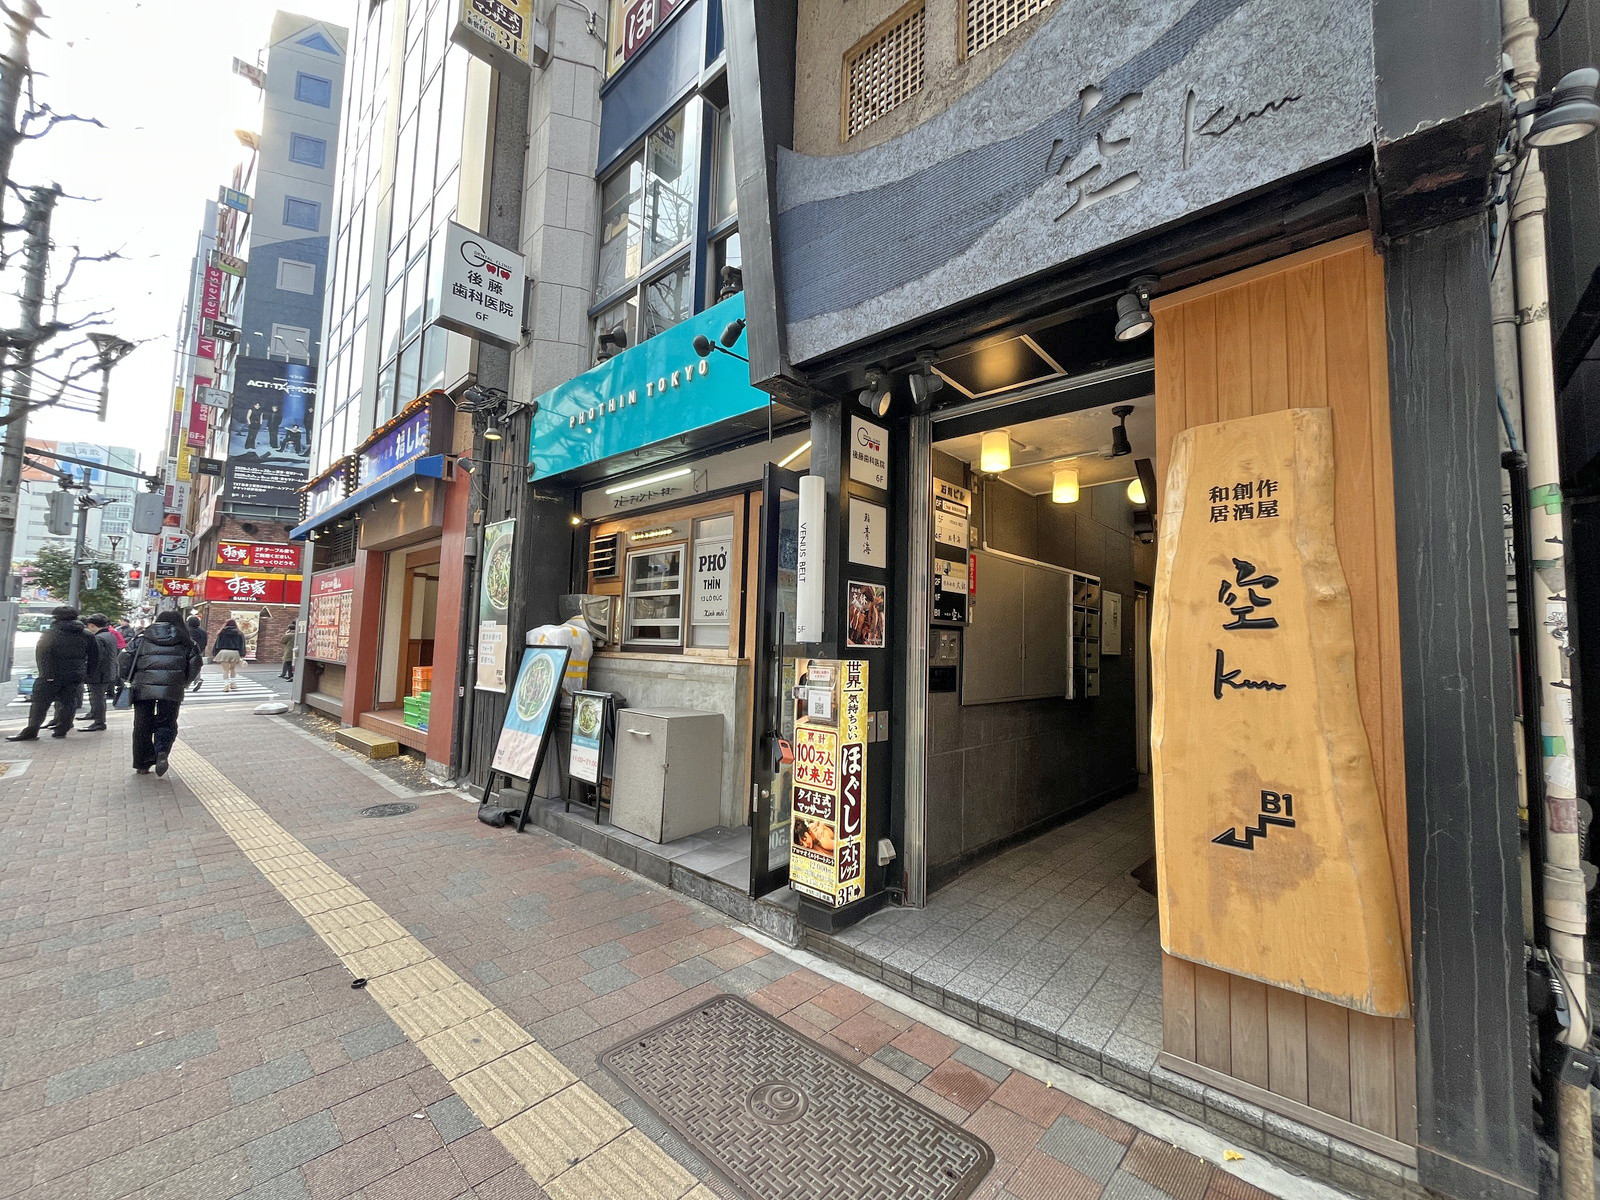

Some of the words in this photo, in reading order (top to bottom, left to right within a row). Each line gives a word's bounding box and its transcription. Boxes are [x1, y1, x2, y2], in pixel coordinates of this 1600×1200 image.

[467, 17, 497, 40] 新宿西口店
[475, 1, 520, 34] マッサージ
[498, 30, 526, 55] 3F
[474, 250, 493, 262] DENTAL
[205, 270, 220, 315] Reverse
[467, 270, 503, 295] 後藤
[452, 282, 514, 317] 歯科医院
[475, 311, 489, 321] 6F
[569, 389, 638, 430] PHOTHIN
[646, 359, 709, 398] TOKYO
[852, 450, 886, 470] 後藤歯科医院
[875, 474, 884, 483] 6F
[940, 483, 966, 502] 石川ビル
[1208, 479, 1279, 503] 和創作
[1208, 498, 1280, 523] 居酒屋
[799, 522, 807, 558] VENUS
[222, 545, 247, 560] すき家
[698, 546, 728, 573] PHỞ
[798, 561, 807, 583] BELT
[167, 580, 190, 592] すき家
[225, 573, 266, 598] すき家
[1217, 557, 1280, 631] 空
[797, 742, 835, 768] 100万人
[796, 765, 835, 787] が来店
[797, 788, 832, 808] タイ古式
[841, 746, 862, 834] ほぐし
[797, 802, 832, 819] マッサージ
[1261, 790, 1295, 817] B1
[838, 884, 854, 906] 3F
